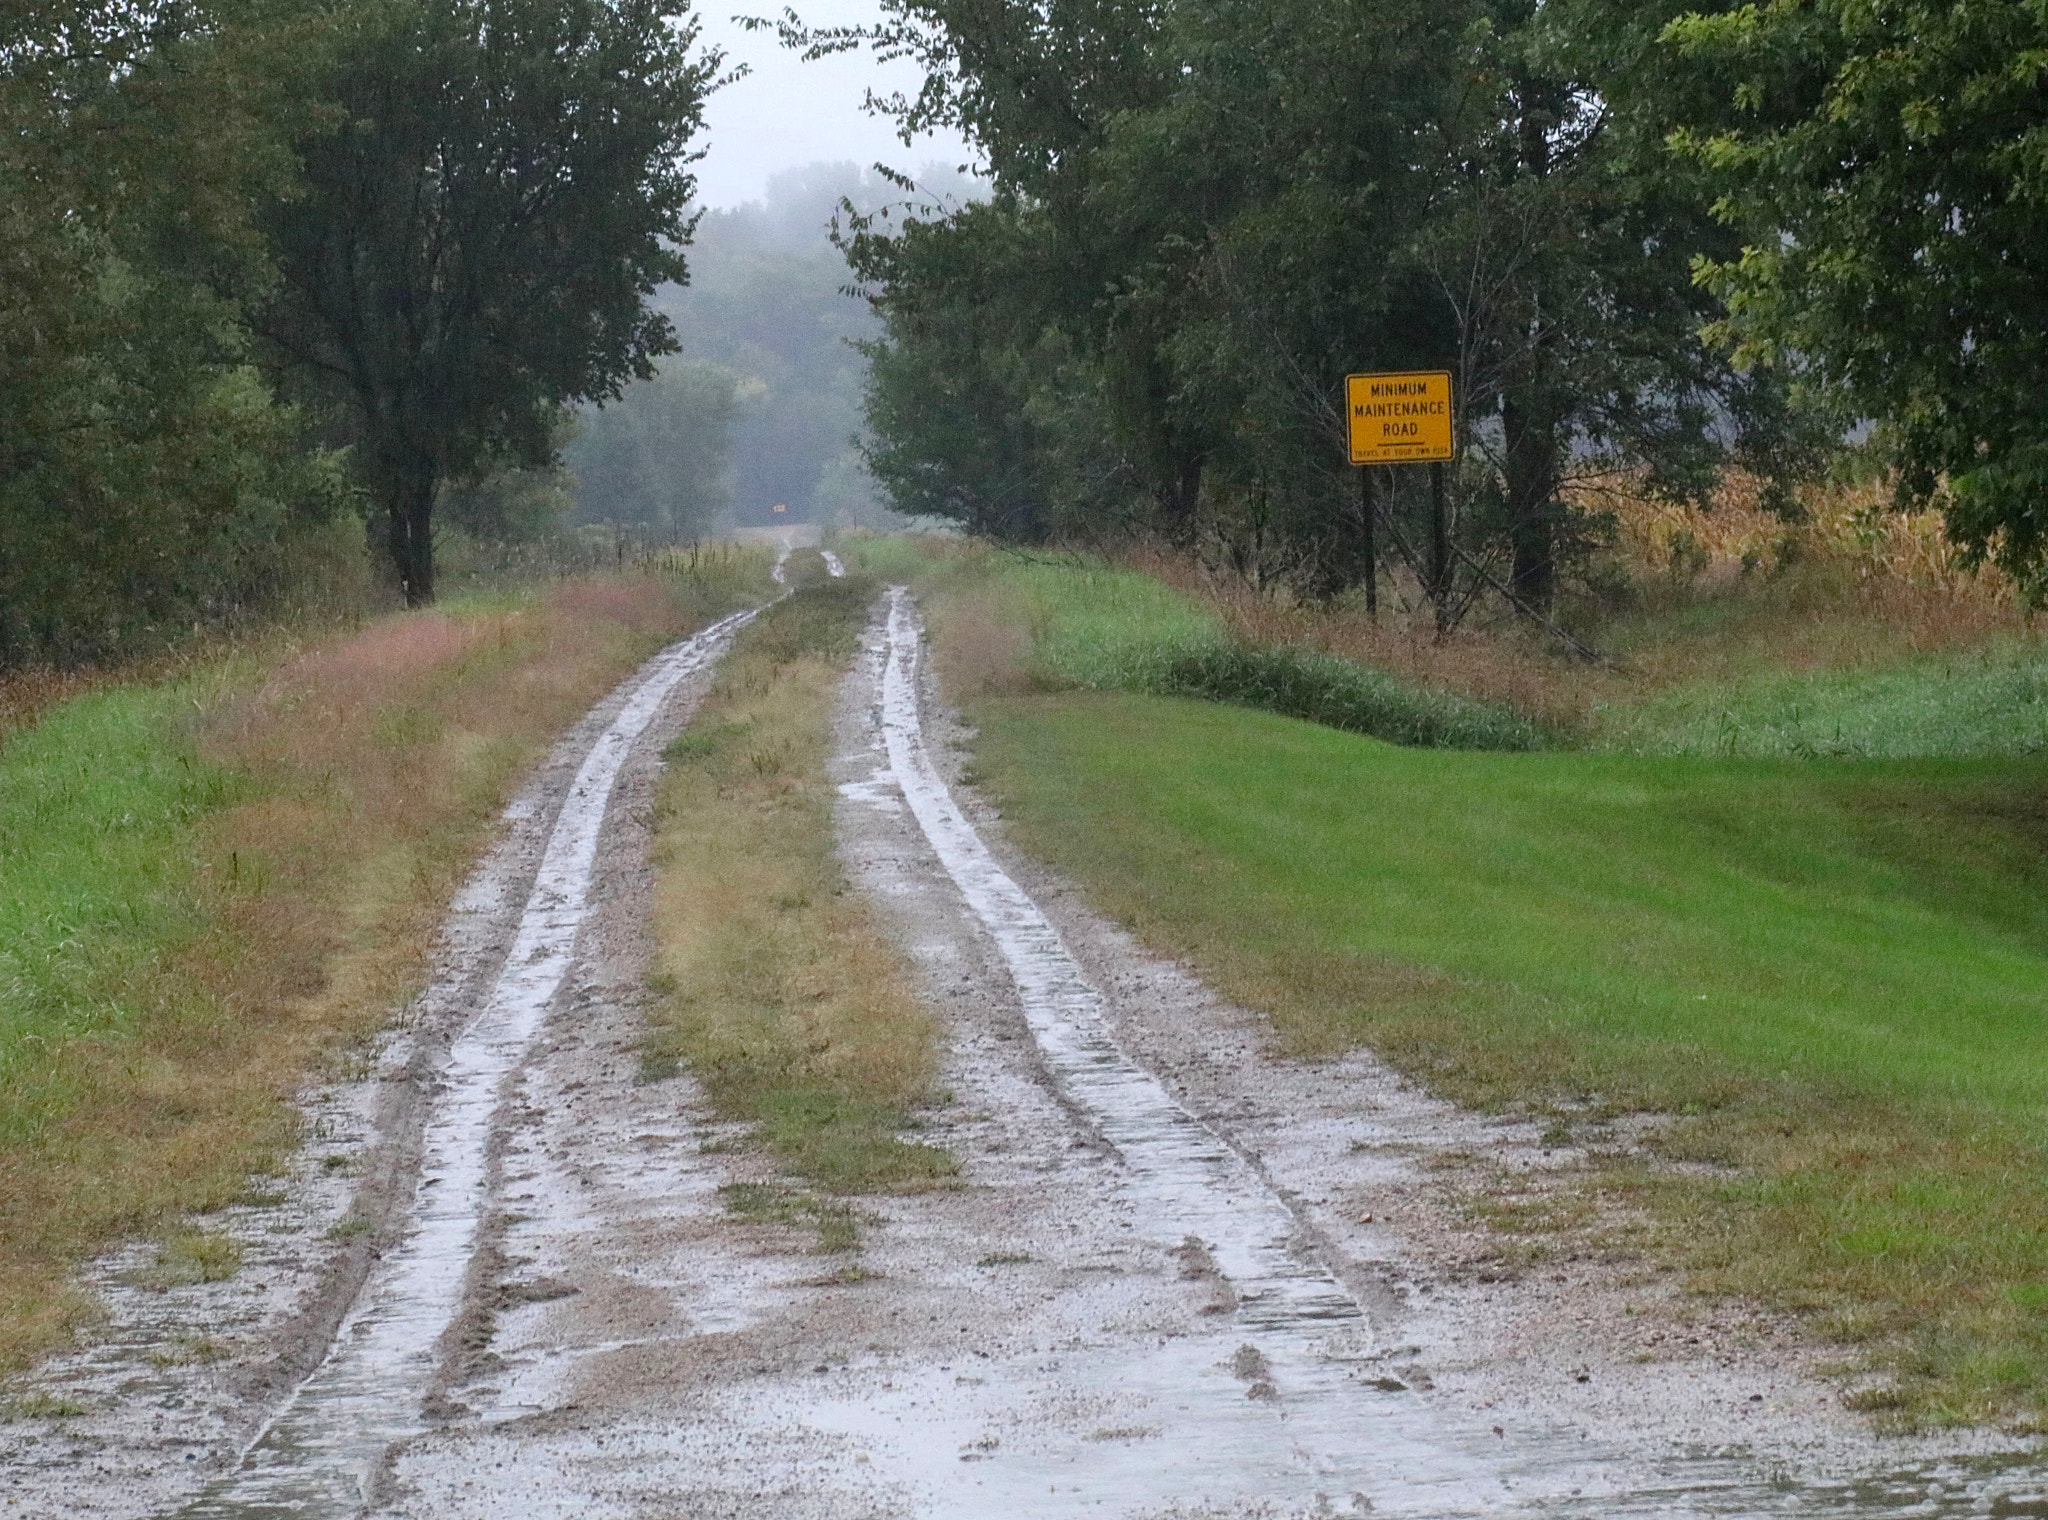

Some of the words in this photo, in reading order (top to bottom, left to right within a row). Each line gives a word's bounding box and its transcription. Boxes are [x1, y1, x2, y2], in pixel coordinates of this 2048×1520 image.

[1371, 382, 1427, 397] MINIMUM
[1354, 401, 1445, 418] MAINTENANCE
[1383, 422, 1418, 437] ROAD
